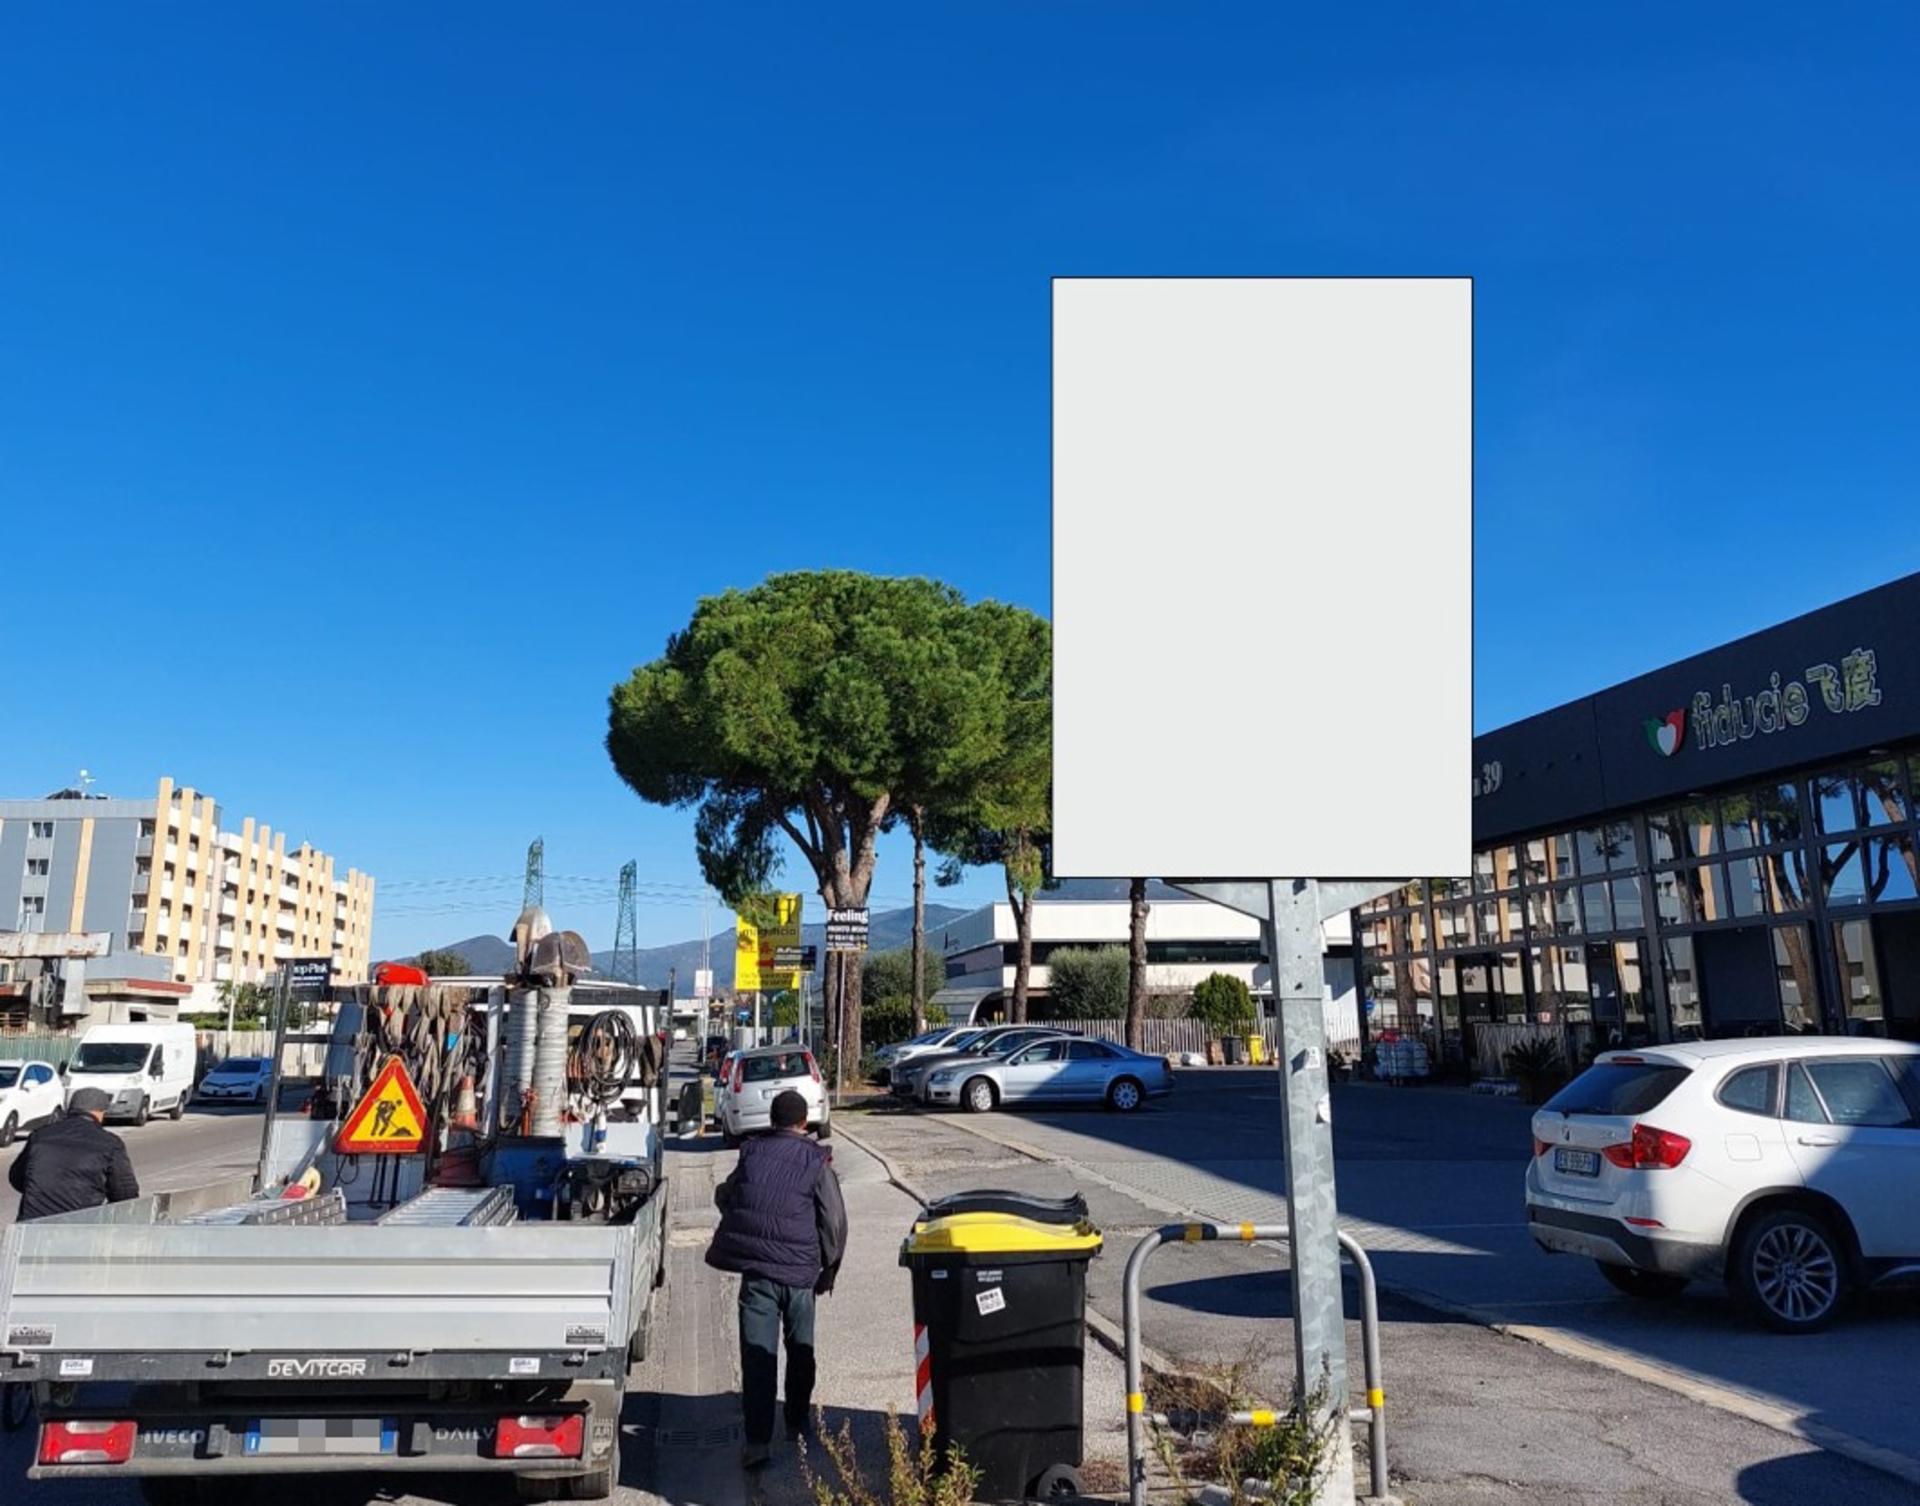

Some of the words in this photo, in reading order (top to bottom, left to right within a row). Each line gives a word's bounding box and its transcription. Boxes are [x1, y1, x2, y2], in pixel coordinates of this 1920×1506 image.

[1805, 648, 1881, 712] 飞度
[1692, 671, 1810, 749] fiducie
[1482, 761, 1503, 794] 39
[827, 909, 869, 924] Feeling
[268, 1359, 366, 1376] DEVITCAR
[144, 1429, 205, 1444] IVECO
[435, 1427, 494, 1441] DAILY
